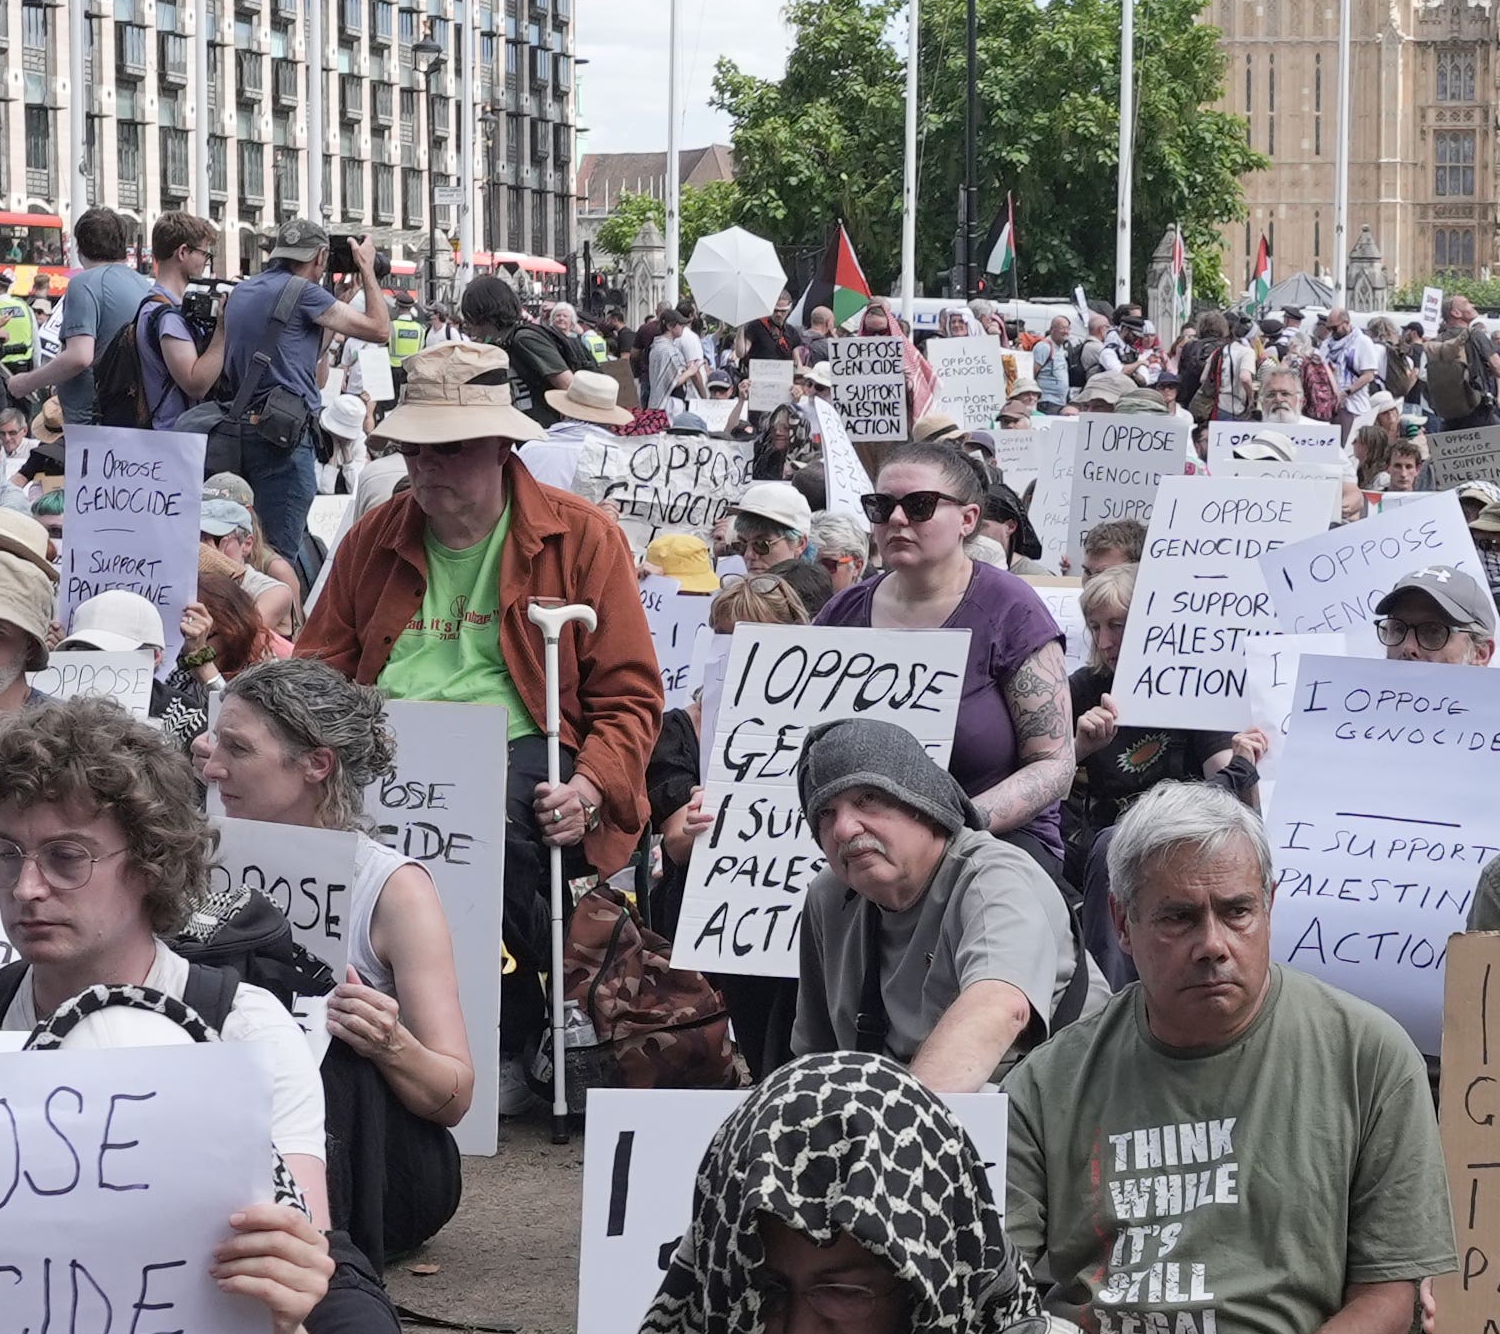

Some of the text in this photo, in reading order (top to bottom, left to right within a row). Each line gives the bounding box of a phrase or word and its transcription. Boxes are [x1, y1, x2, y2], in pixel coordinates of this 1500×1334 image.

[832, 359, 901, 375] GENOCIDE
[847, 341, 903, 359] OPPOSE
[941, 355, 988, 366] OPPOSE
[937, 366, 994, 377] GENOCIDE
[832, 383, 903, 400] I SUPPORT
[846, 419, 900, 435] ACTION
[1102, 424, 1175, 452] OPPOSE
[1446, 432, 1481, 444] OPPOSE
[630, 444, 753, 489] OPPOSE
[1451, 454, 1495, 469] SUPPORT
[75, 486, 182, 517] GENOCIDE
[1200, 499, 1293, 525] OPPOSE
[1309, 519, 1443, 584] OPPOSE
[733, 642, 760, 707] I
[764, 644, 959, 712] OPPOSE
[1133, 666, 1247, 699] ACTION
[1304, 681, 1470, 716] I OPPOSE
[709, 793, 734, 849] I
[1280, 821, 1500, 866] I SUPPORT
[1482, 964, 1491, 1065] I
[1108, 1117, 1237, 1173] THINK
[609, 1131, 634, 1236] I
[1108, 1162, 1239, 1220] WHILE
[1468, 1178, 1478, 1229] I
[1111, 1222, 1183, 1267] IT'S
[1098, 1262, 1214, 1304] STILL
